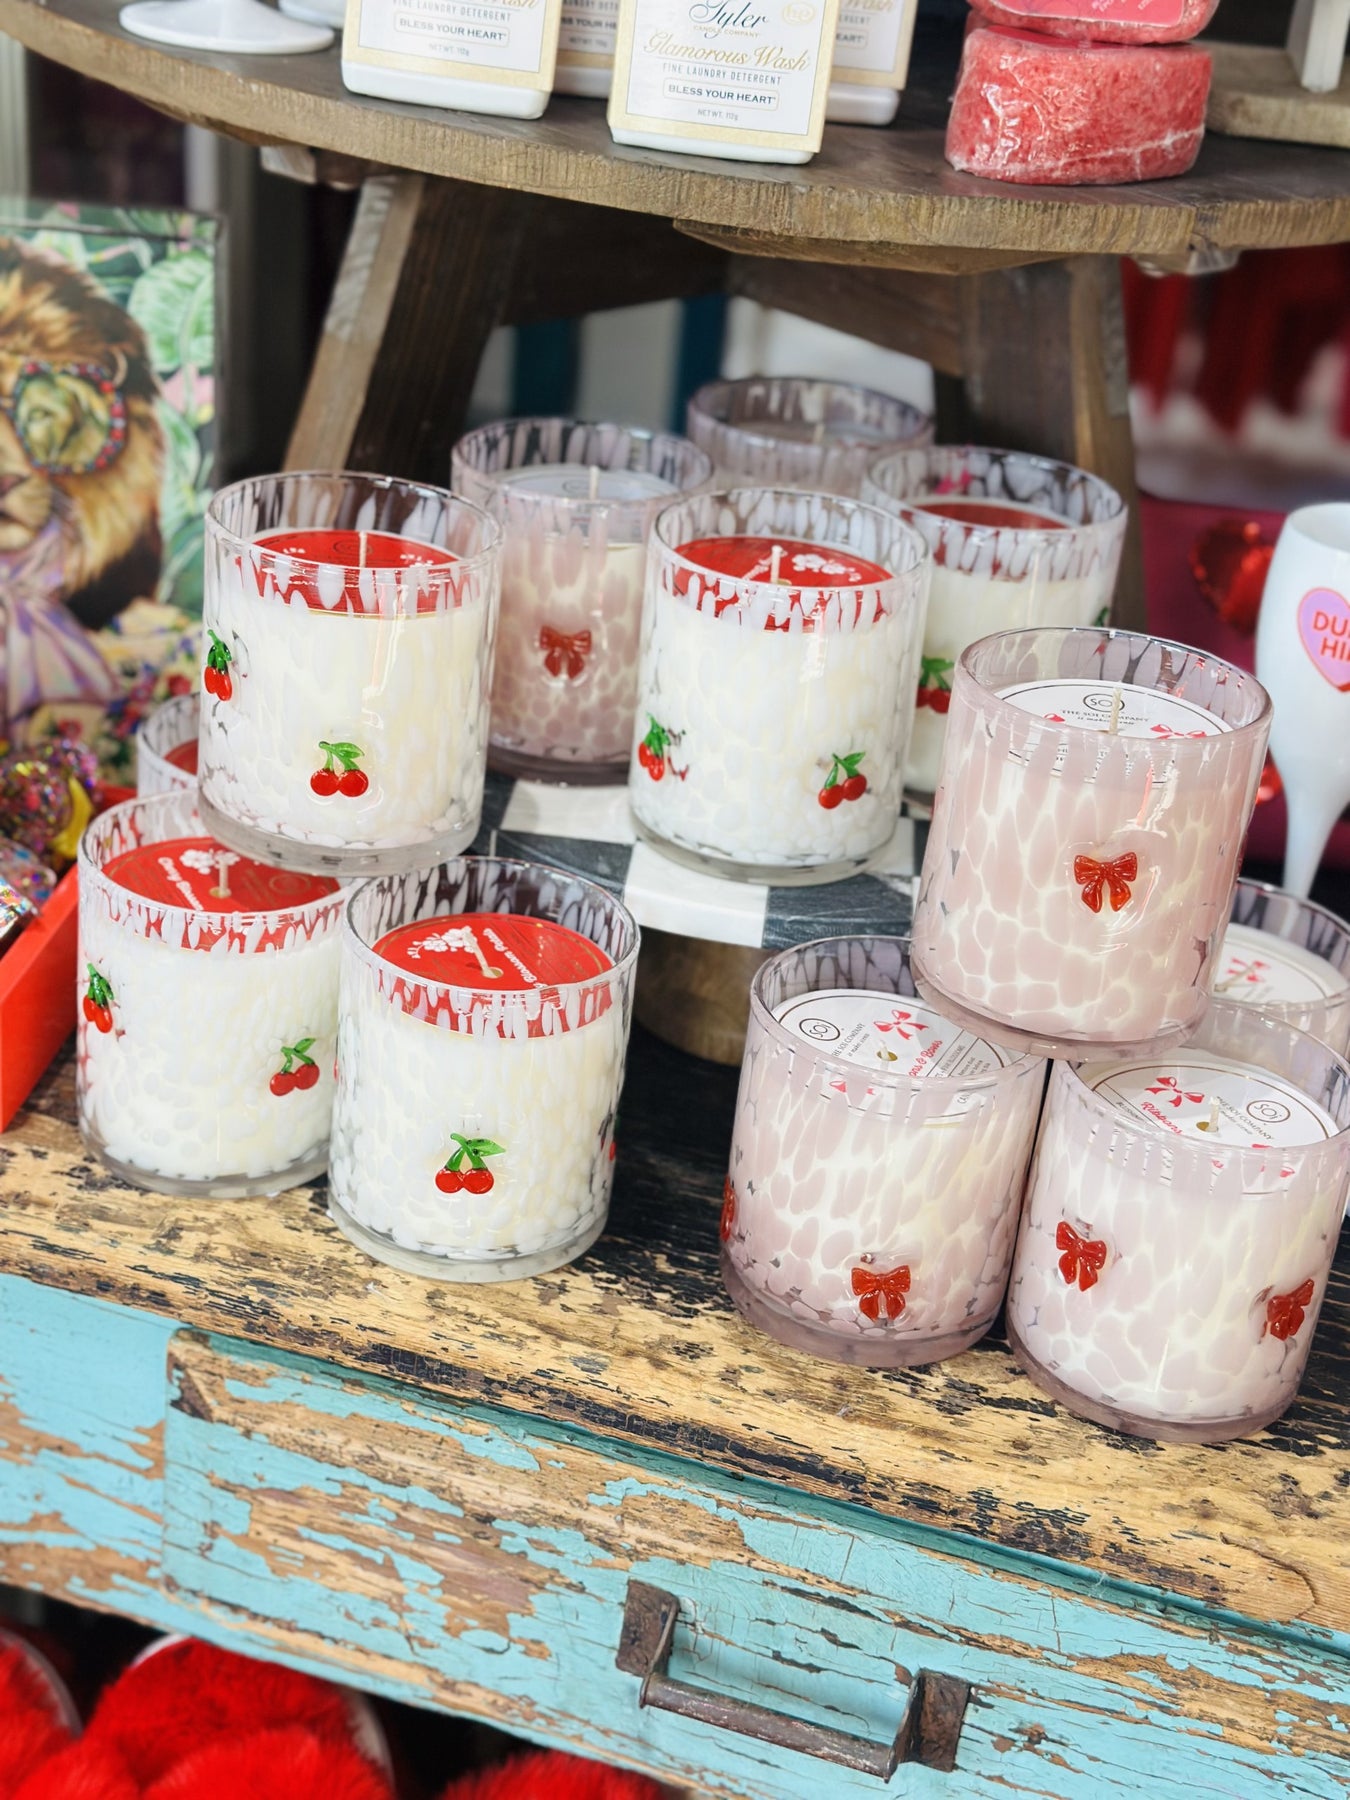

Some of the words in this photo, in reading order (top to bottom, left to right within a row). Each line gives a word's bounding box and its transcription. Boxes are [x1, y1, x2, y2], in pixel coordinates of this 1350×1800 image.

[460, 7, 512, 22] DETERGENT
[688, 0, 770, 39] Tyler
[400, 17, 434, 31] BLESS
[437, 24, 465, 36] YOUR
[467, 28, 504, 41] HEART
[723, 28, 760, 38] COMPANY
[643, 28, 748, 65] Glamorous
[753, 46, 811, 70] Wash
[662, 62, 682, 74] FINE
[686, 65, 727, 80] LAUNDRY
[730, 71, 782, 86] DETERGENT
[668, 84, 703, 97] BLESS
[705, 89, 734, 101] YOUR
[736, 94, 773, 105] HEART
[1313, 610, 1350, 638] DU
[483, 927, 508, 952] Petals
[504, 950, 537, 983] Blossom
[921, 1040, 943, 1058] Bows
[1141, 1101, 1184, 1134] Ribbons
